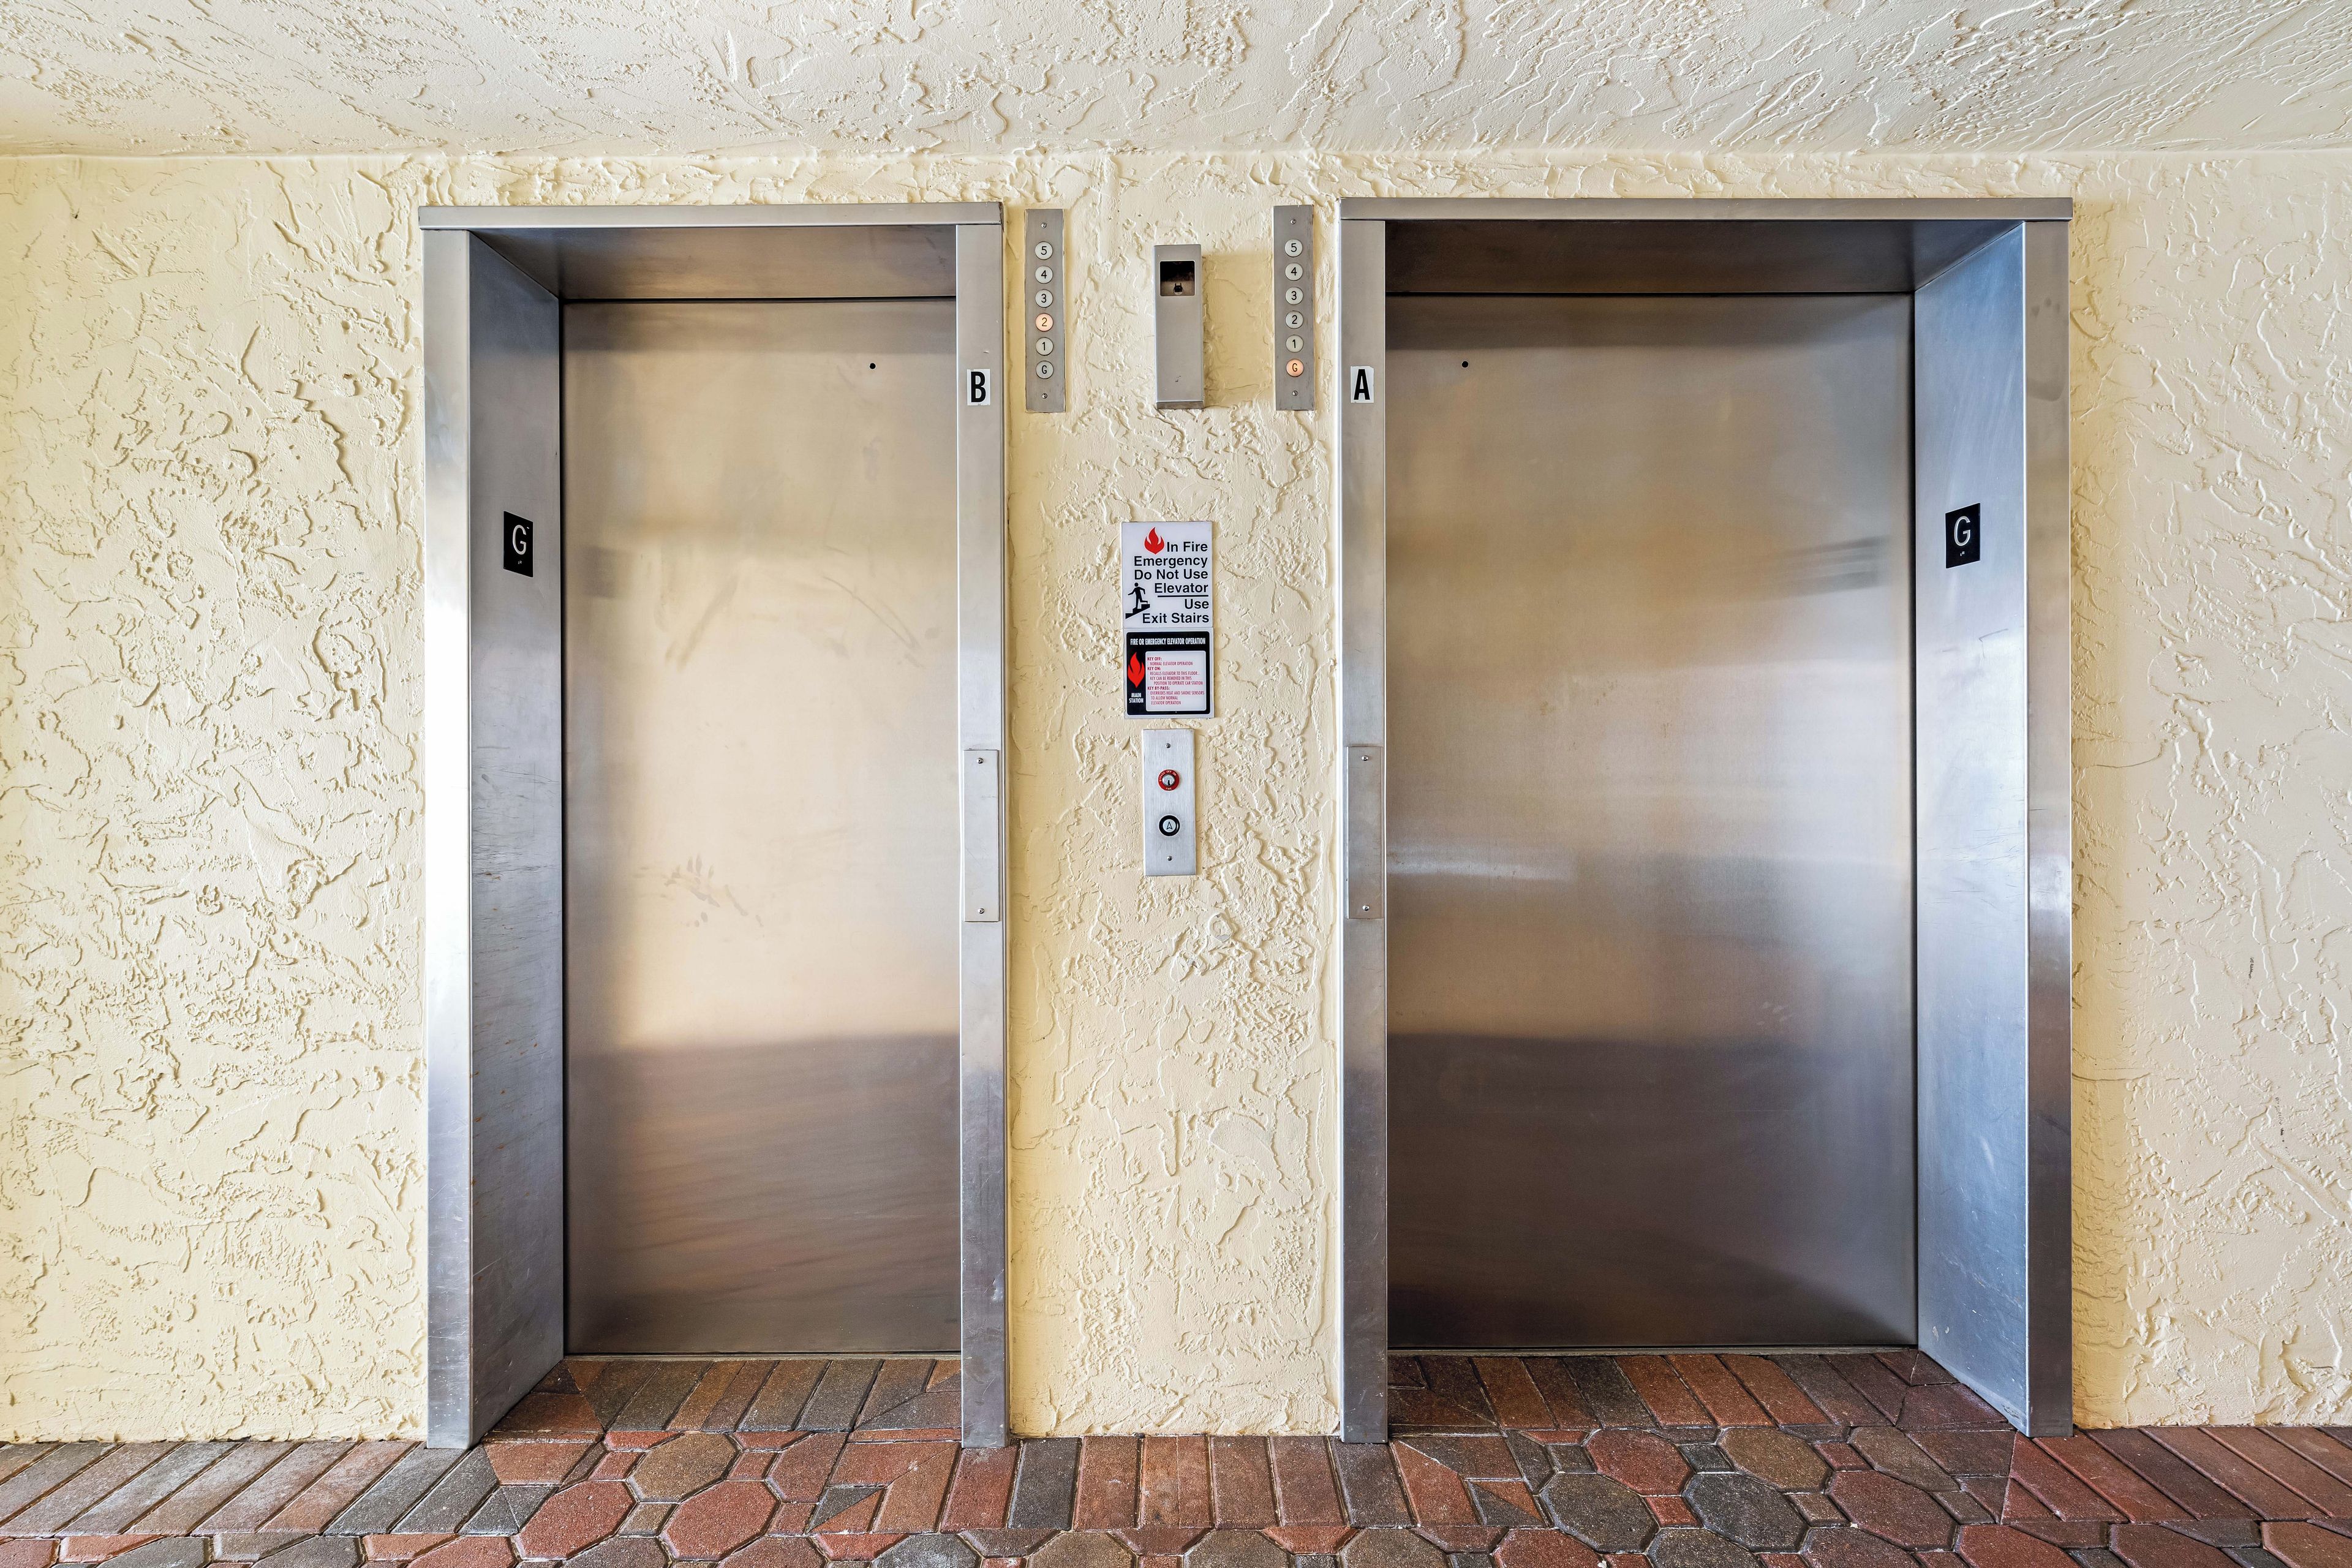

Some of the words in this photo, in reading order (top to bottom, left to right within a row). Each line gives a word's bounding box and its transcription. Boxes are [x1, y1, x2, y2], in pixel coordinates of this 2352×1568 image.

[1040, 246, 1047, 255] 5
[1291, 243, 1297, 252] 5
[1041, 270, 1047, 279] 4
[1291, 267, 1297, 276] 4
[1041, 293, 1047, 303] 3
[1291, 291, 1297, 300] 3
[1041, 317, 1047, 327] 2
[1291, 315, 1298, 325] 2
[1042, 342, 1046, 351] 1
[1292, 339, 1296, 349] 1
[1041, 365, 1047, 374] G
[1292, 363, 1298, 372] G
[971, 371, 986, 403] B
[1354, 369, 1371, 400] A
[1954, 516, 1970, 546] G
[512, 524, 527, 555] G
[1167, 541, 1178, 552] In
[1183, 541, 1208, 552] Fire
[1134, 556, 1208, 568] Emergency
[1134, 569, 1152, 580] Do
[1156, 569, 1179, 579] Not
[1183, 568, 1208, 579] Use
[1155, 582, 1208, 594] Elevator
[1185, 598, 1209, 609] Use
[1142, 612, 1167, 624] Exit
[1171, 612, 1209, 624] Stairs
